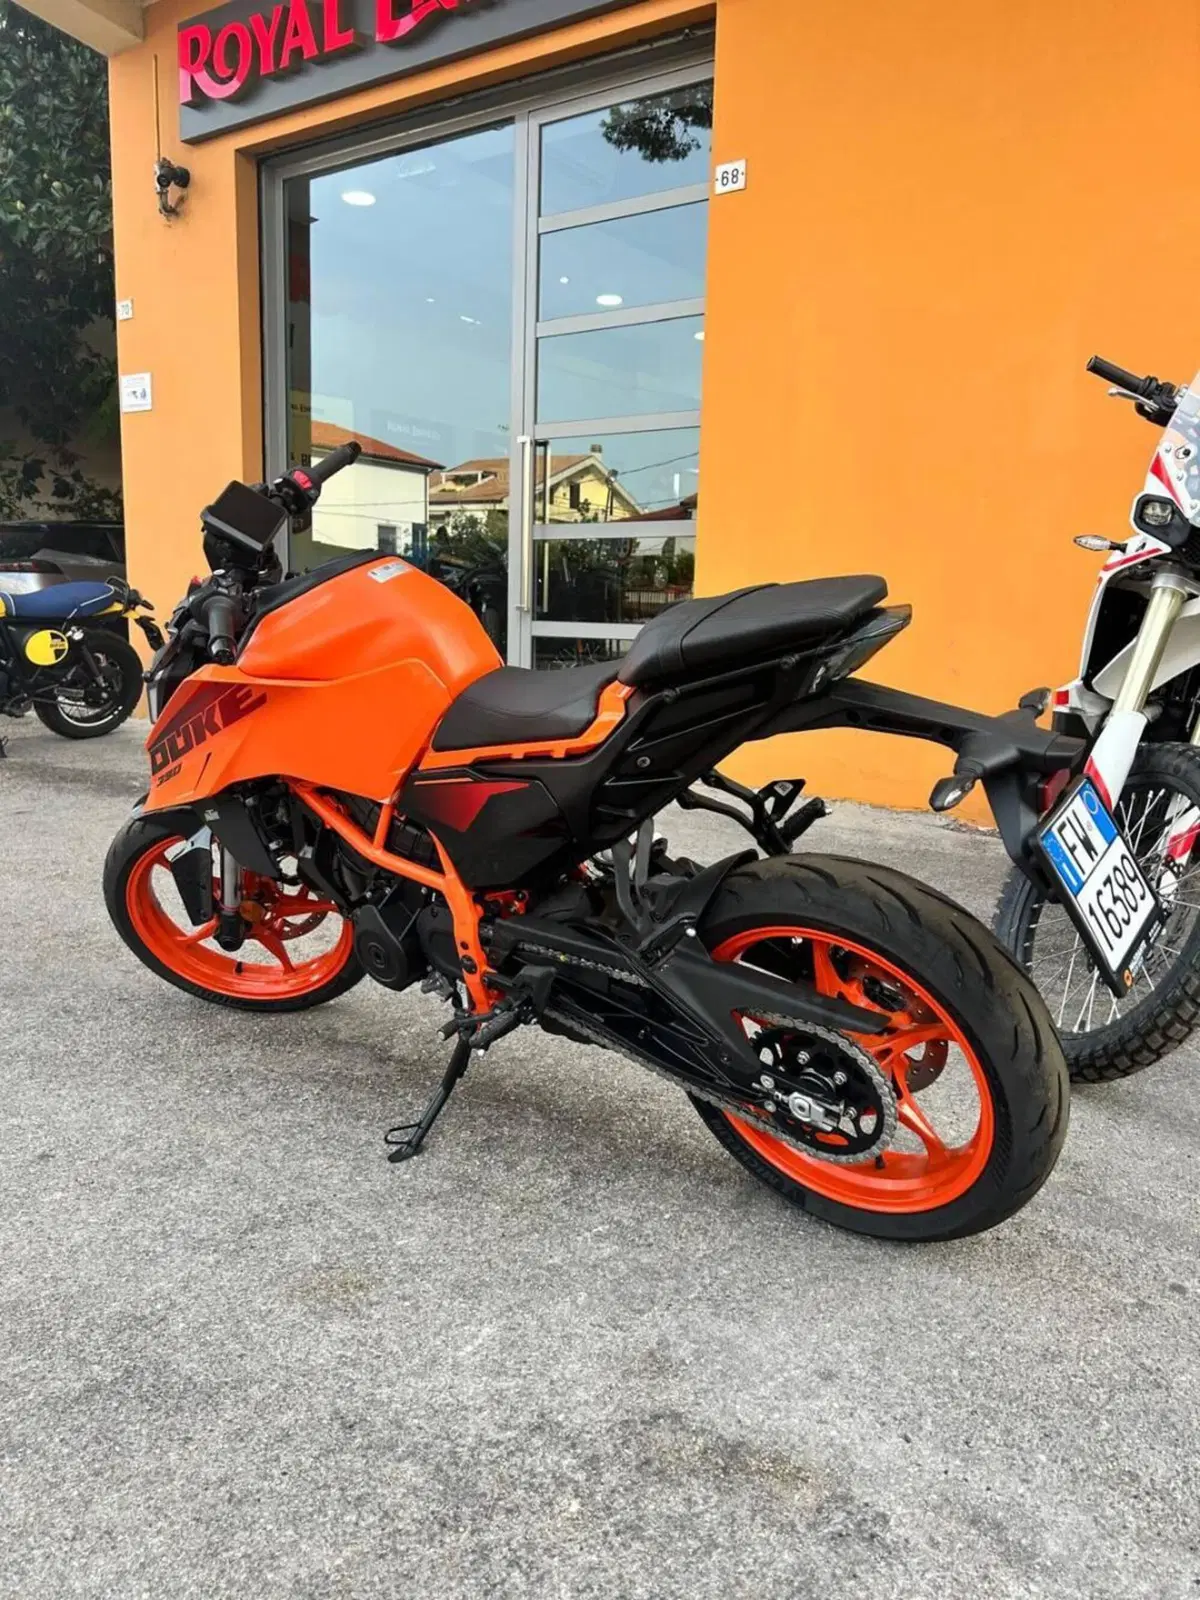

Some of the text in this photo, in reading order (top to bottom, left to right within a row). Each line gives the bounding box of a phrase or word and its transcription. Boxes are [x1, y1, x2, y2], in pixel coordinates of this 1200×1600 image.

[178, 0, 355, 104] ROYAL
[720, 168, 740, 187] 68
[150, 684, 268, 776] DUKE
[1057, 808, 1099, 876] FW
[1088, 853, 1146, 952] 16389
